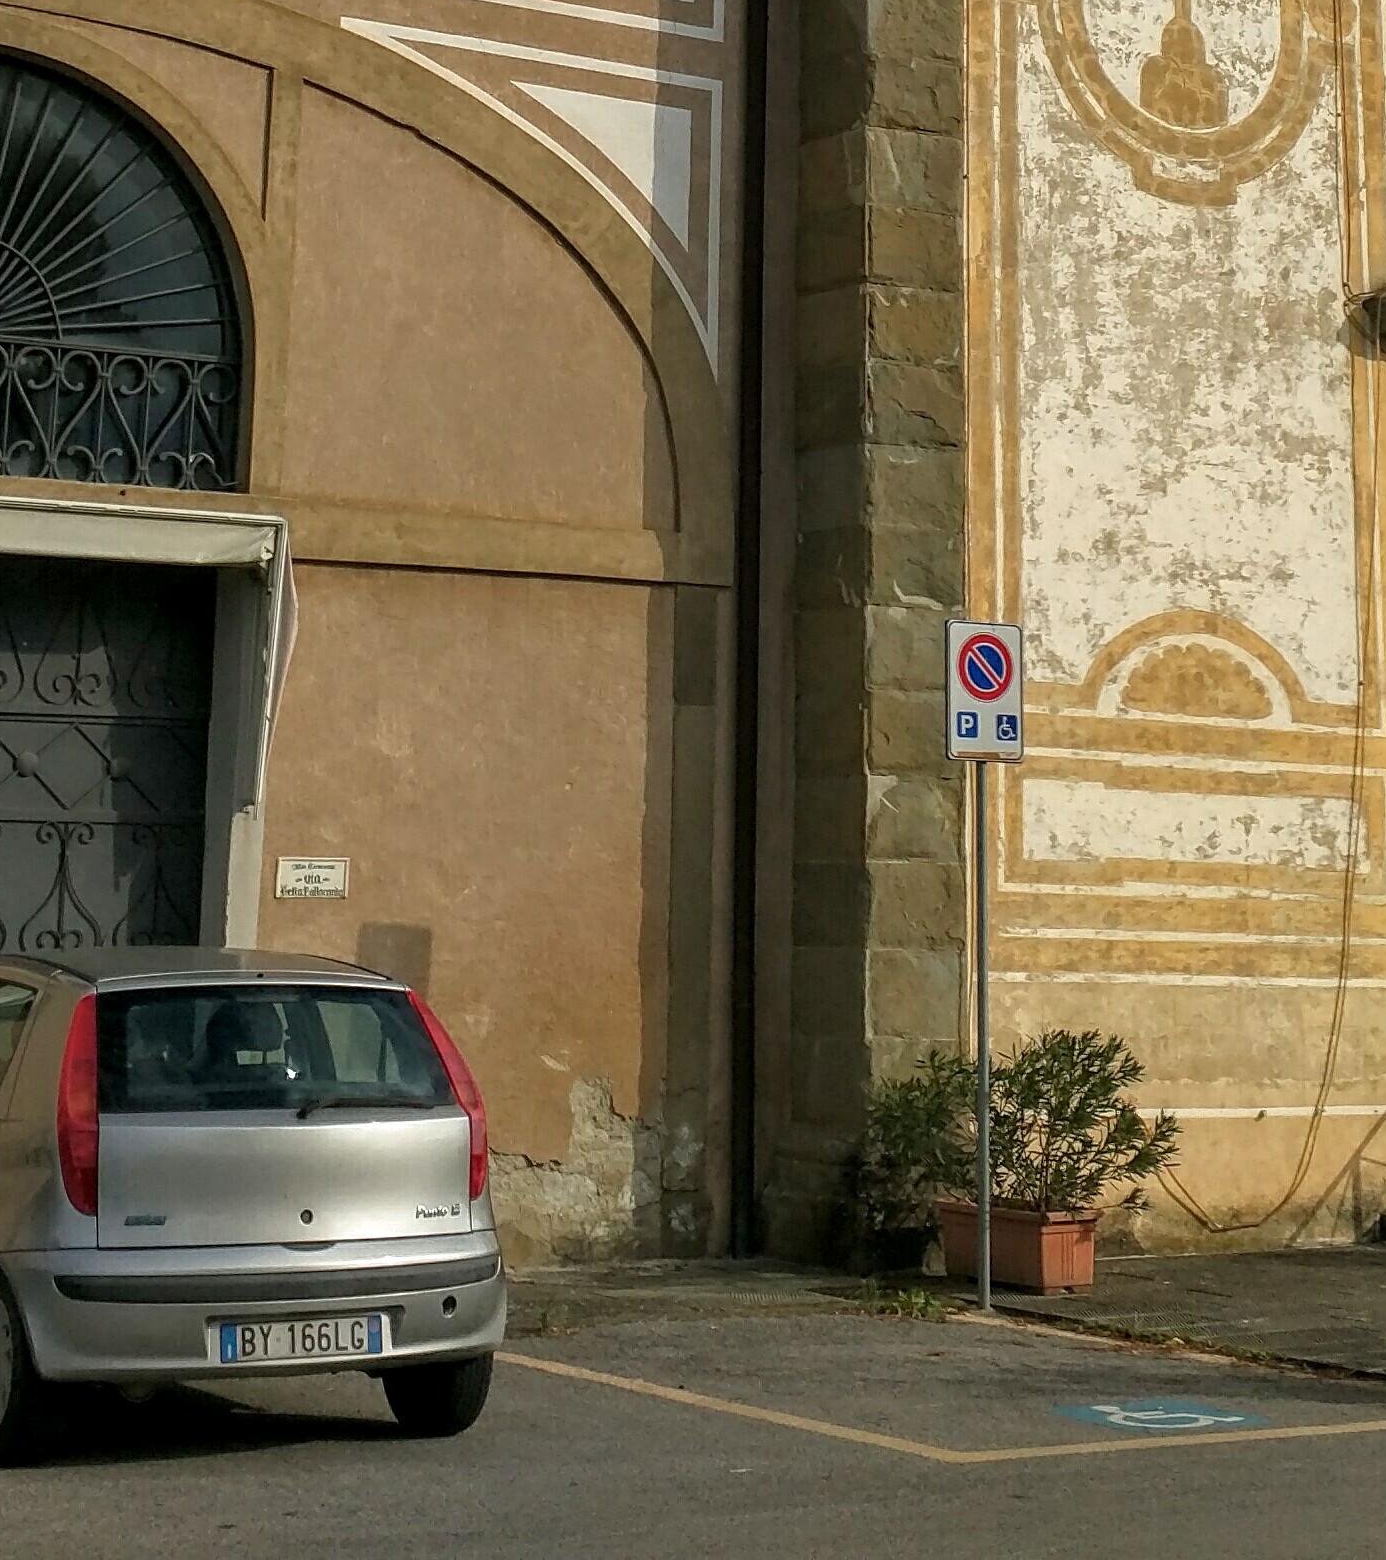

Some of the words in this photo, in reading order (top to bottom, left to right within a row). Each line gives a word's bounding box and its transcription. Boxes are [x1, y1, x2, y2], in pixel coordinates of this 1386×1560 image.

[962, 715, 974, 734] P
[241, 1325, 272, 1356] BY
[288, 1321, 364, 1354] 166LG
